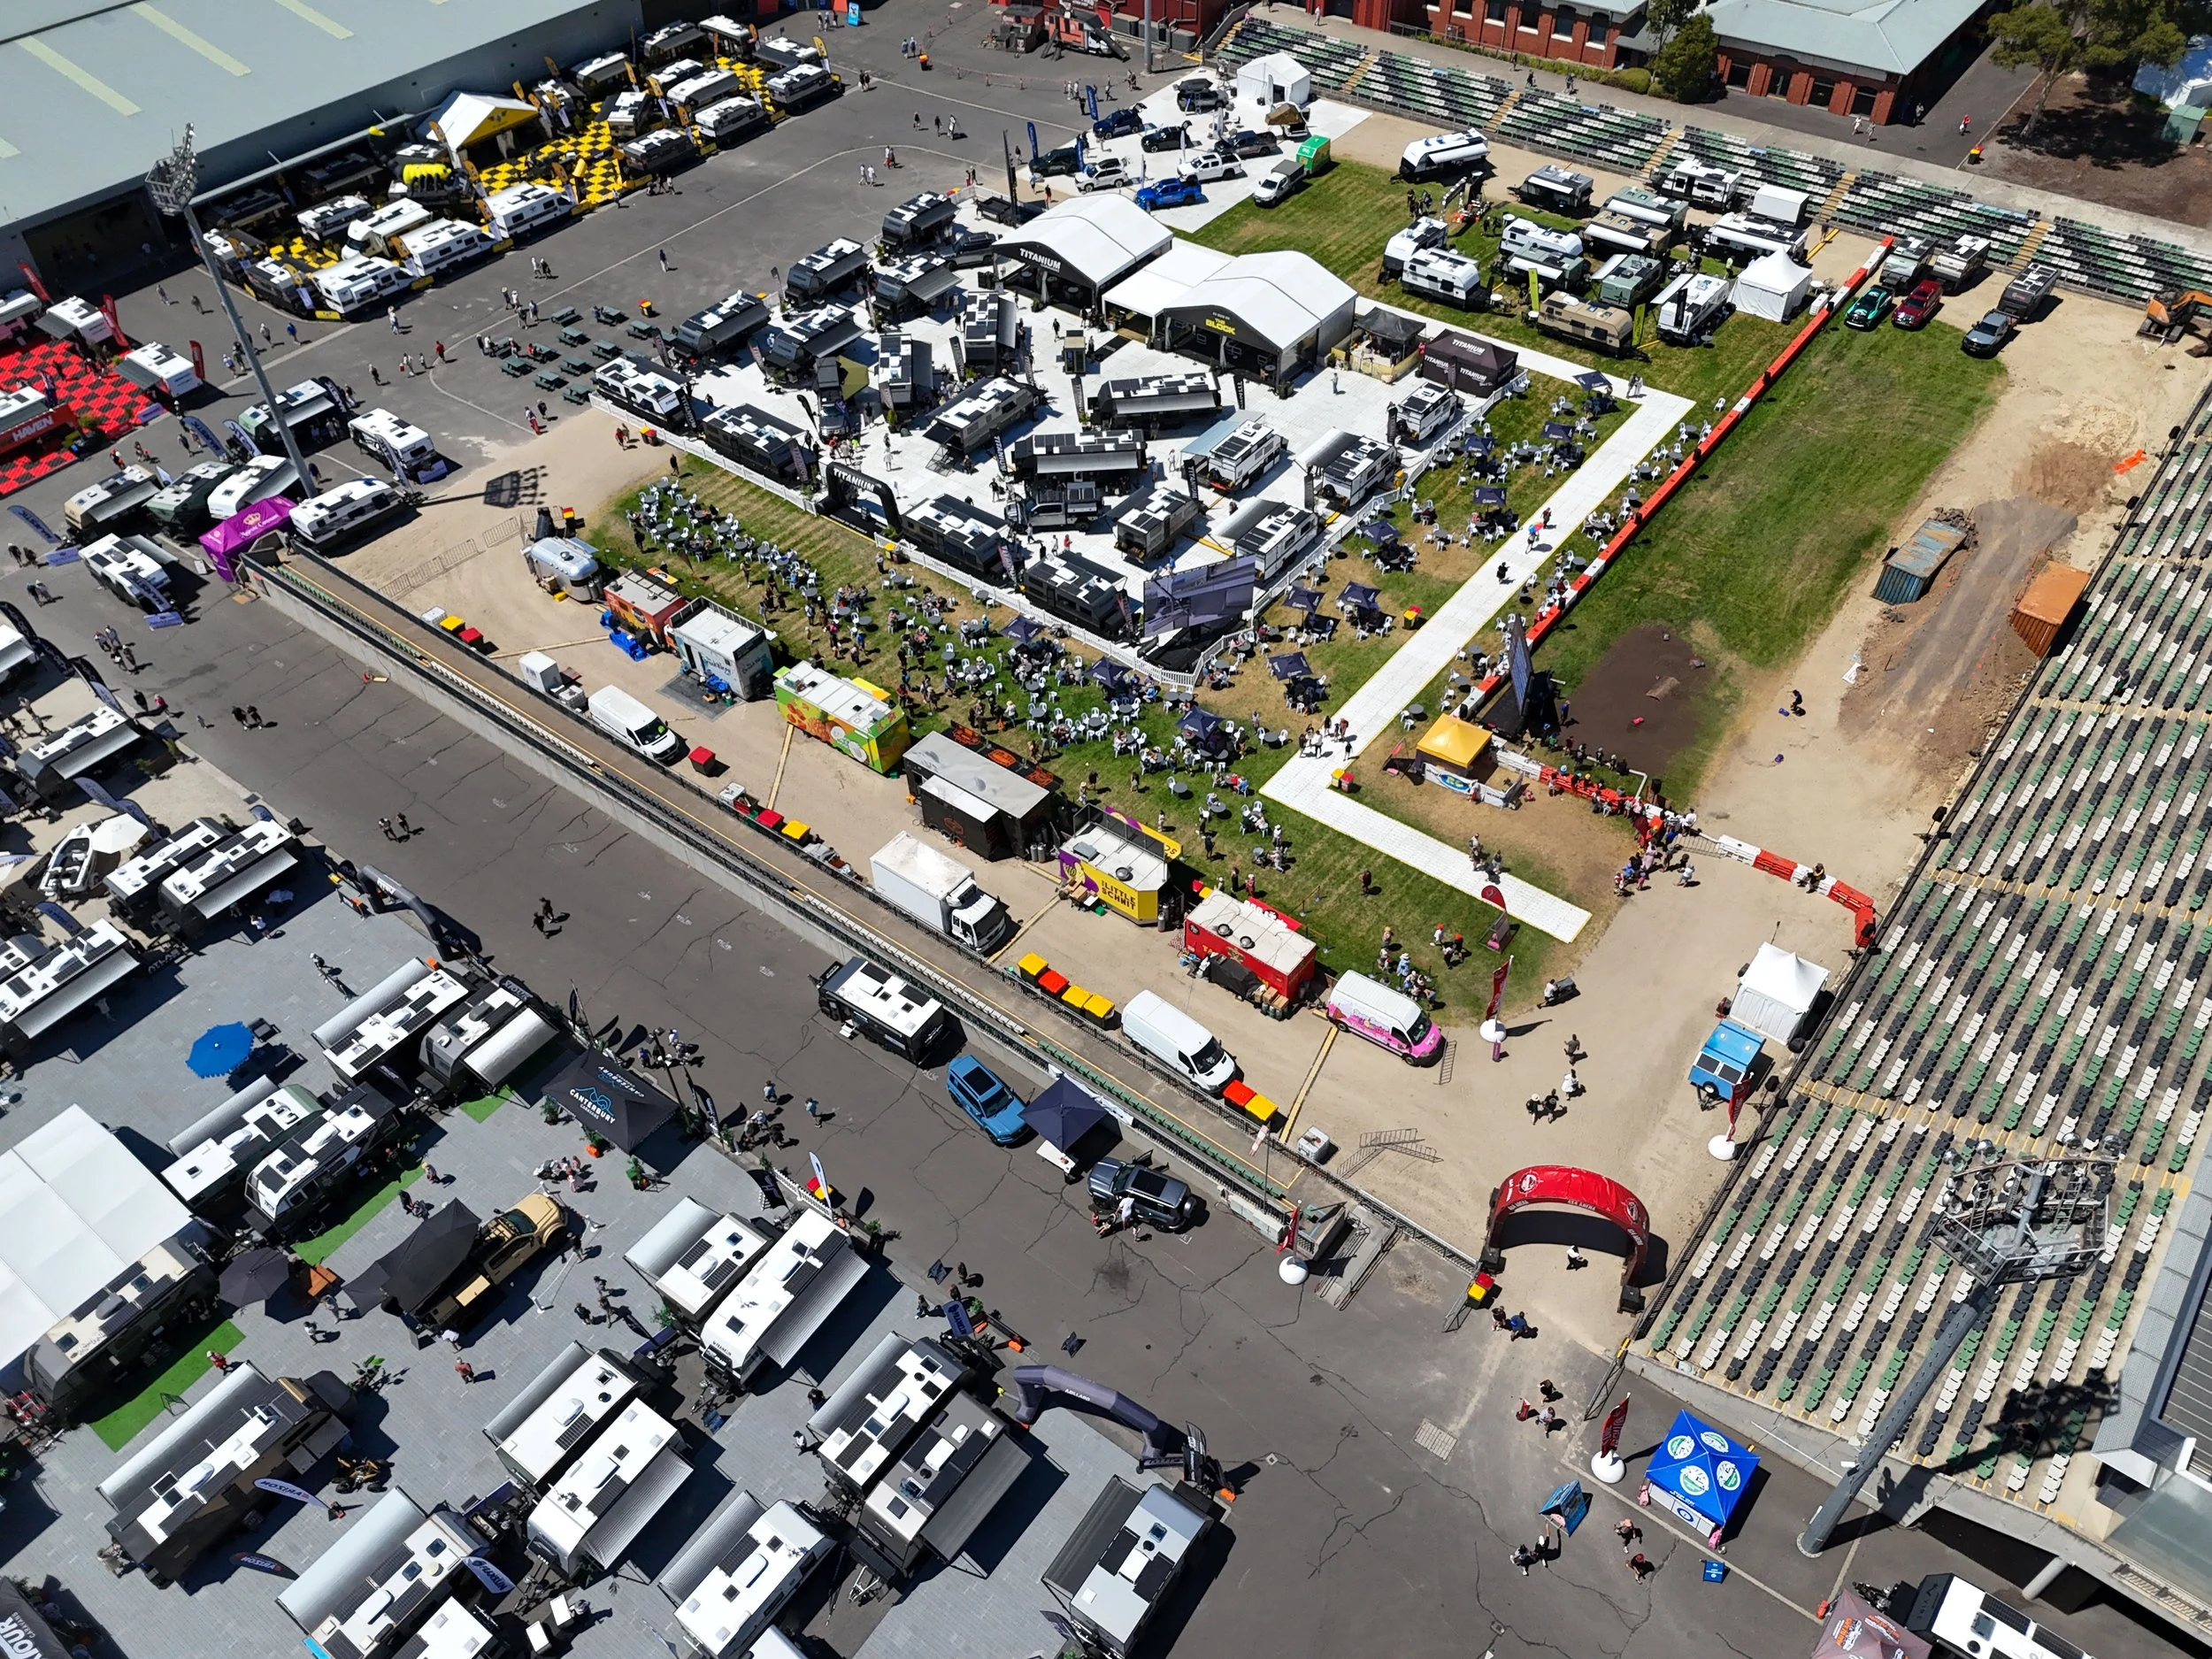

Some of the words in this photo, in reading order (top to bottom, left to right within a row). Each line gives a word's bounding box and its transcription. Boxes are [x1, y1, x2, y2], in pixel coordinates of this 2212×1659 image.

[1019, 248, 1061, 270] TITANIUM
[1205, 319, 1236, 335] BLOCK
[1452, 339, 1485, 355] TITANIUM
[1425, 355, 1449, 368] TITANIUM
[1460, 367, 1486, 381] TITANIUM
[12, 414, 54, 442] HAVEN
[995, 435, 1006, 471] TITANIUM
[833, 468, 875, 492] TITANIUM
[1102, 887, 1136, 910] SCHNIT
[1105, 880, 1136, 903] LITTLE
[569, 1088, 616, 1124] CANTERBURY
[580, 1103, 600, 1119] CARAVANS
[13, 1611, 35, 1639] CARAVANS
